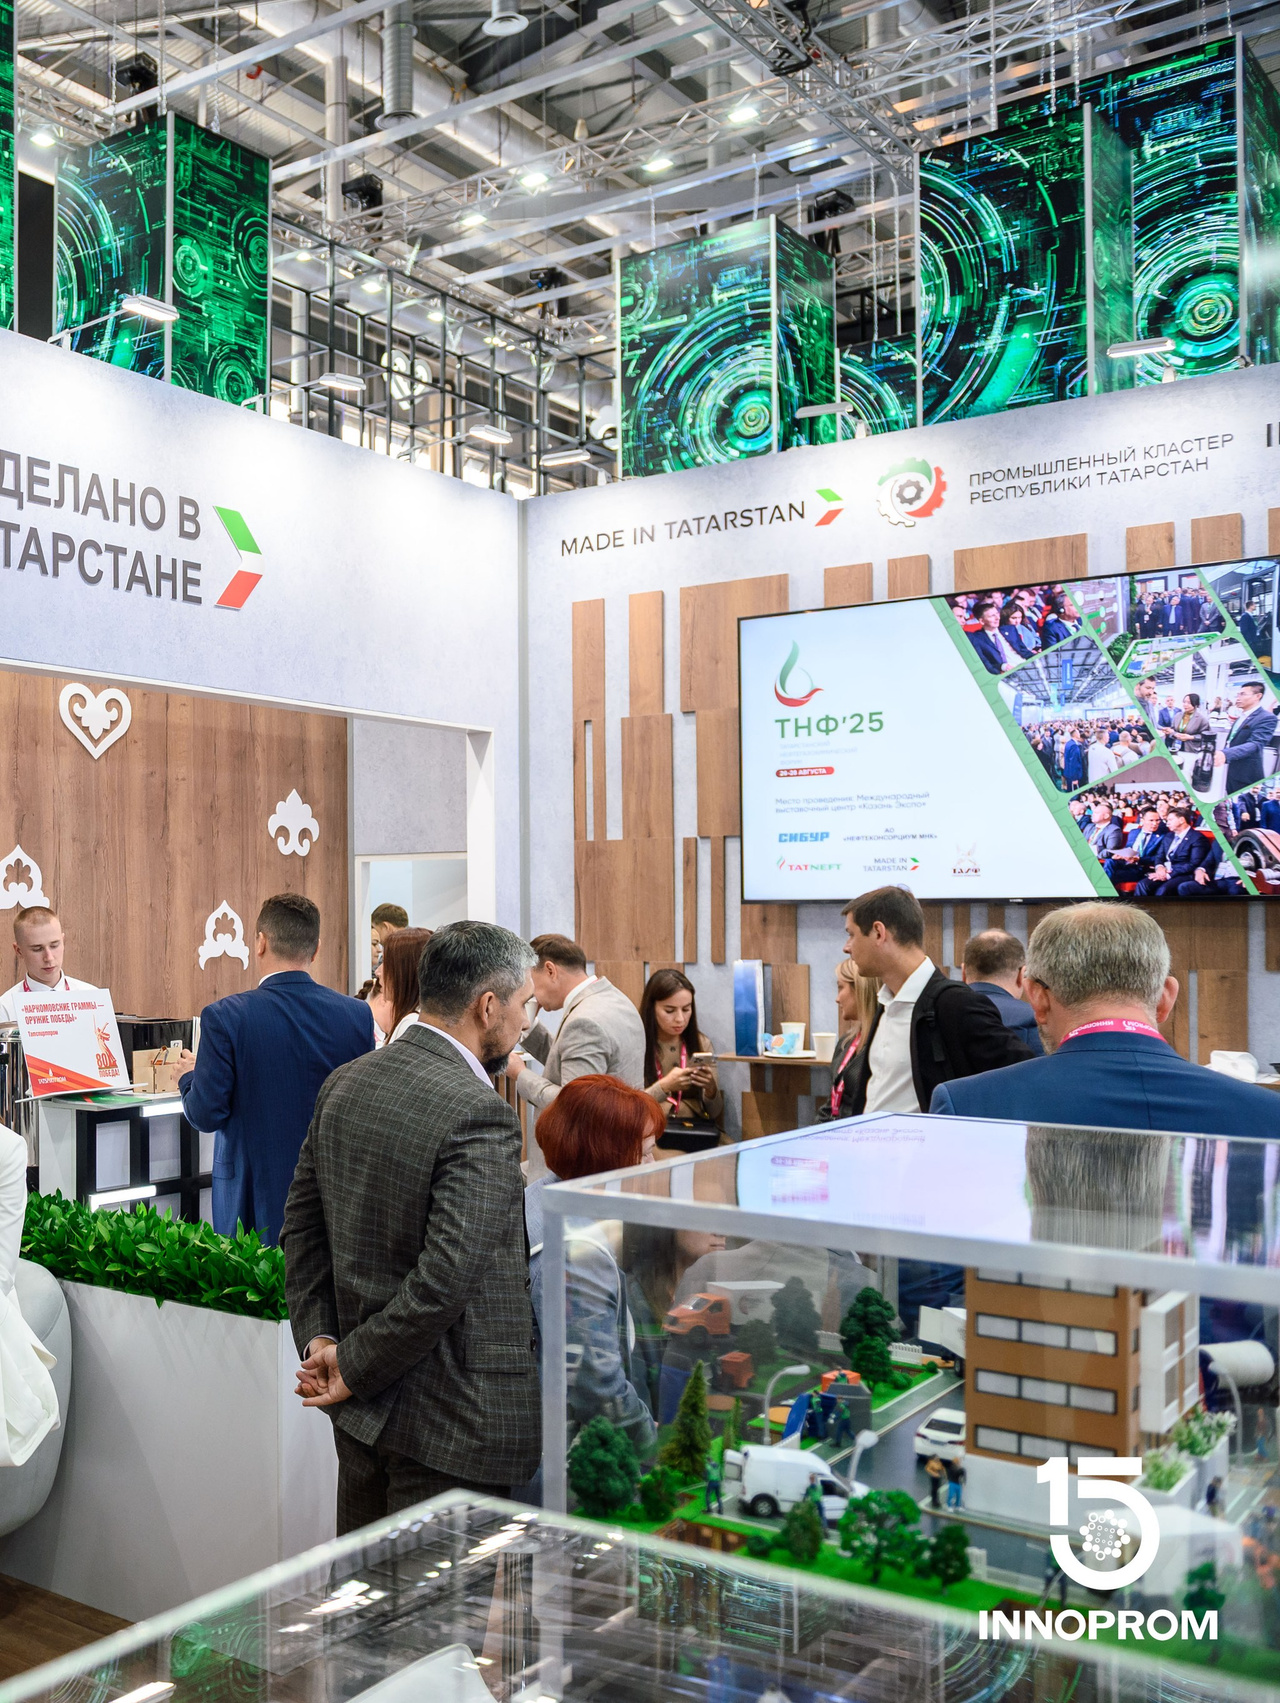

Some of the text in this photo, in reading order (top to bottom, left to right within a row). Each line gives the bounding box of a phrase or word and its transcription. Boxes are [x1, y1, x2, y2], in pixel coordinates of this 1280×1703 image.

[970, 433, 1234, 487] ПРОМЫШЛЕННЫЙ КЛАСТЕР
[970, 457, 1209, 505] РЕСПУБЛИКИ ТАТАРСТАН
[178, 496, 201, 541] В
[562, 501, 805, 557] MADE IN TATARSTAN
[779, 832, 830, 843] СИБУР
[788, 864, 842, 872] TATNEFT
[25, 1015, 50, 1025] ОРУЖИЕ
[72, 1002, 97, 1010] ГРАММЫ
